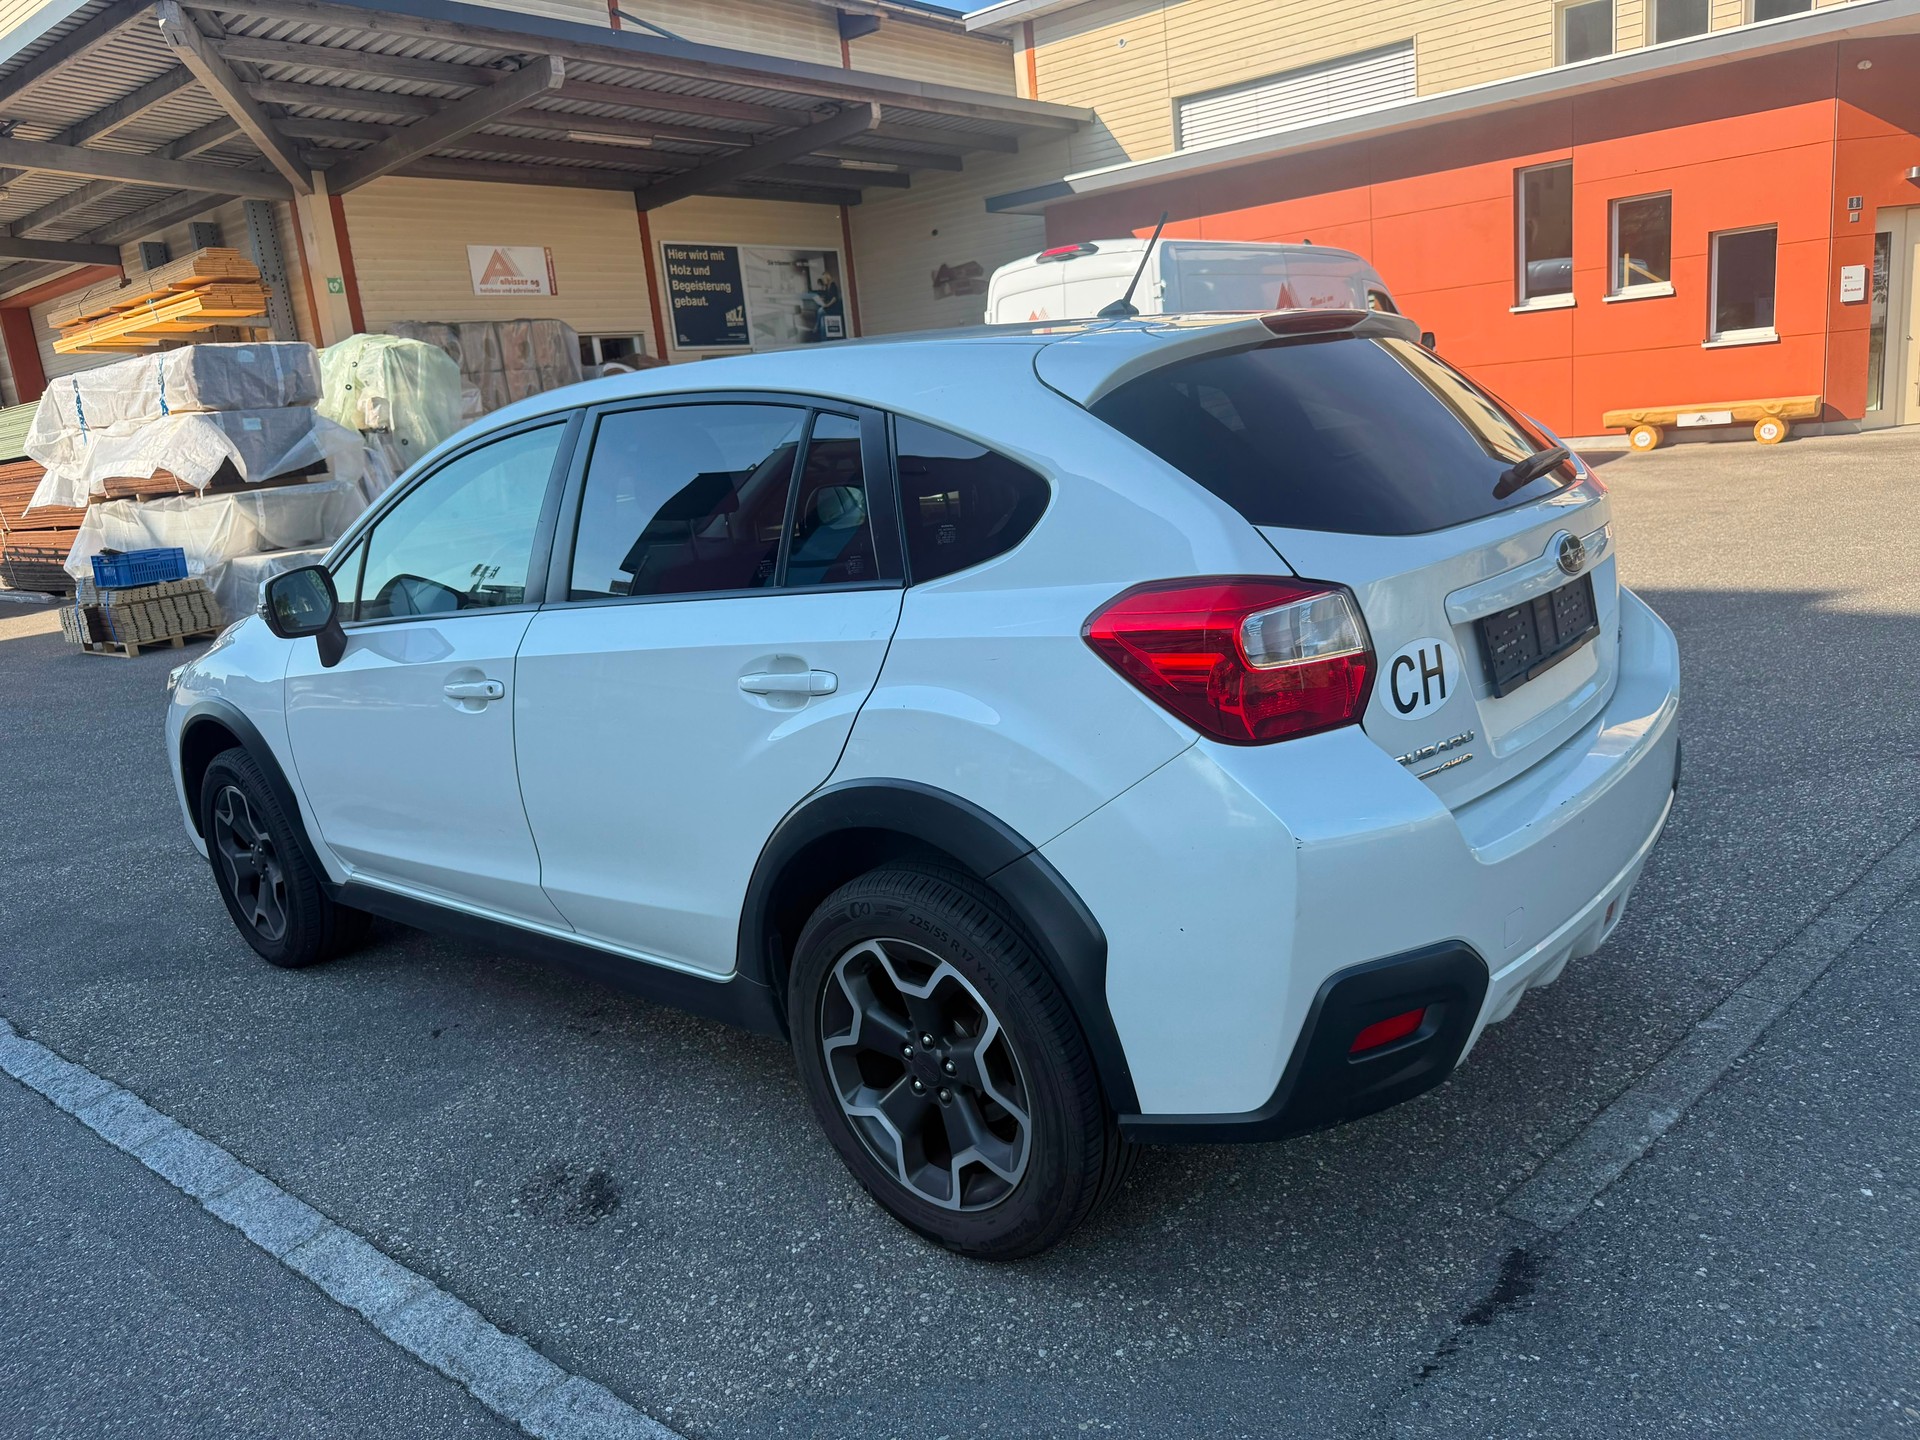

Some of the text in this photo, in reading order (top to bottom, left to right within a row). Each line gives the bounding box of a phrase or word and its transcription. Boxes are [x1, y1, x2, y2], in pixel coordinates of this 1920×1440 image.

[667, 248, 725, 261] Hier wird mit
[669, 264, 711, 276] Holz und
[672, 280, 732, 293] Begeisterung
[674, 295, 709, 308] gebaut.
[1390, 644, 1446, 714] CH
[909, 913, 949, 942] 225/55
[950, 940, 961, 952] R
[961, 948, 975, 962] 17
[984, 972, 1000, 994] XL
